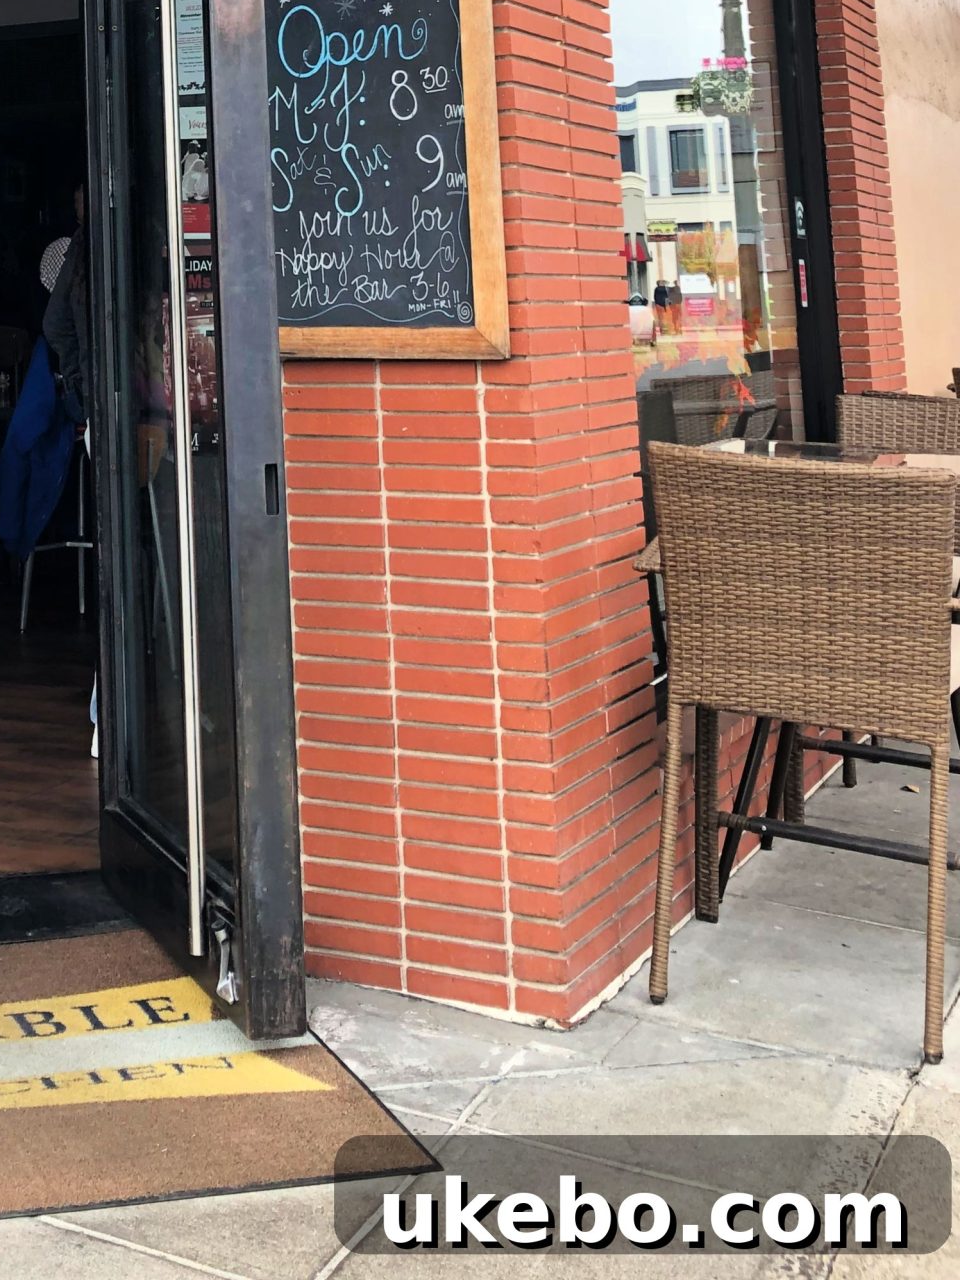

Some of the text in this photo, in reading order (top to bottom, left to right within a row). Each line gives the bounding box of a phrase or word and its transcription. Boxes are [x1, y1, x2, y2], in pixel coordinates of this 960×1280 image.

[277, 5, 428, 107] Open
[415, 134, 445, 192] 9
[362, 206, 400, 237] us
[185, 260, 213, 272] IDAY
[290, 278, 349, 309] the
[351, 274, 407, 304] Bar
